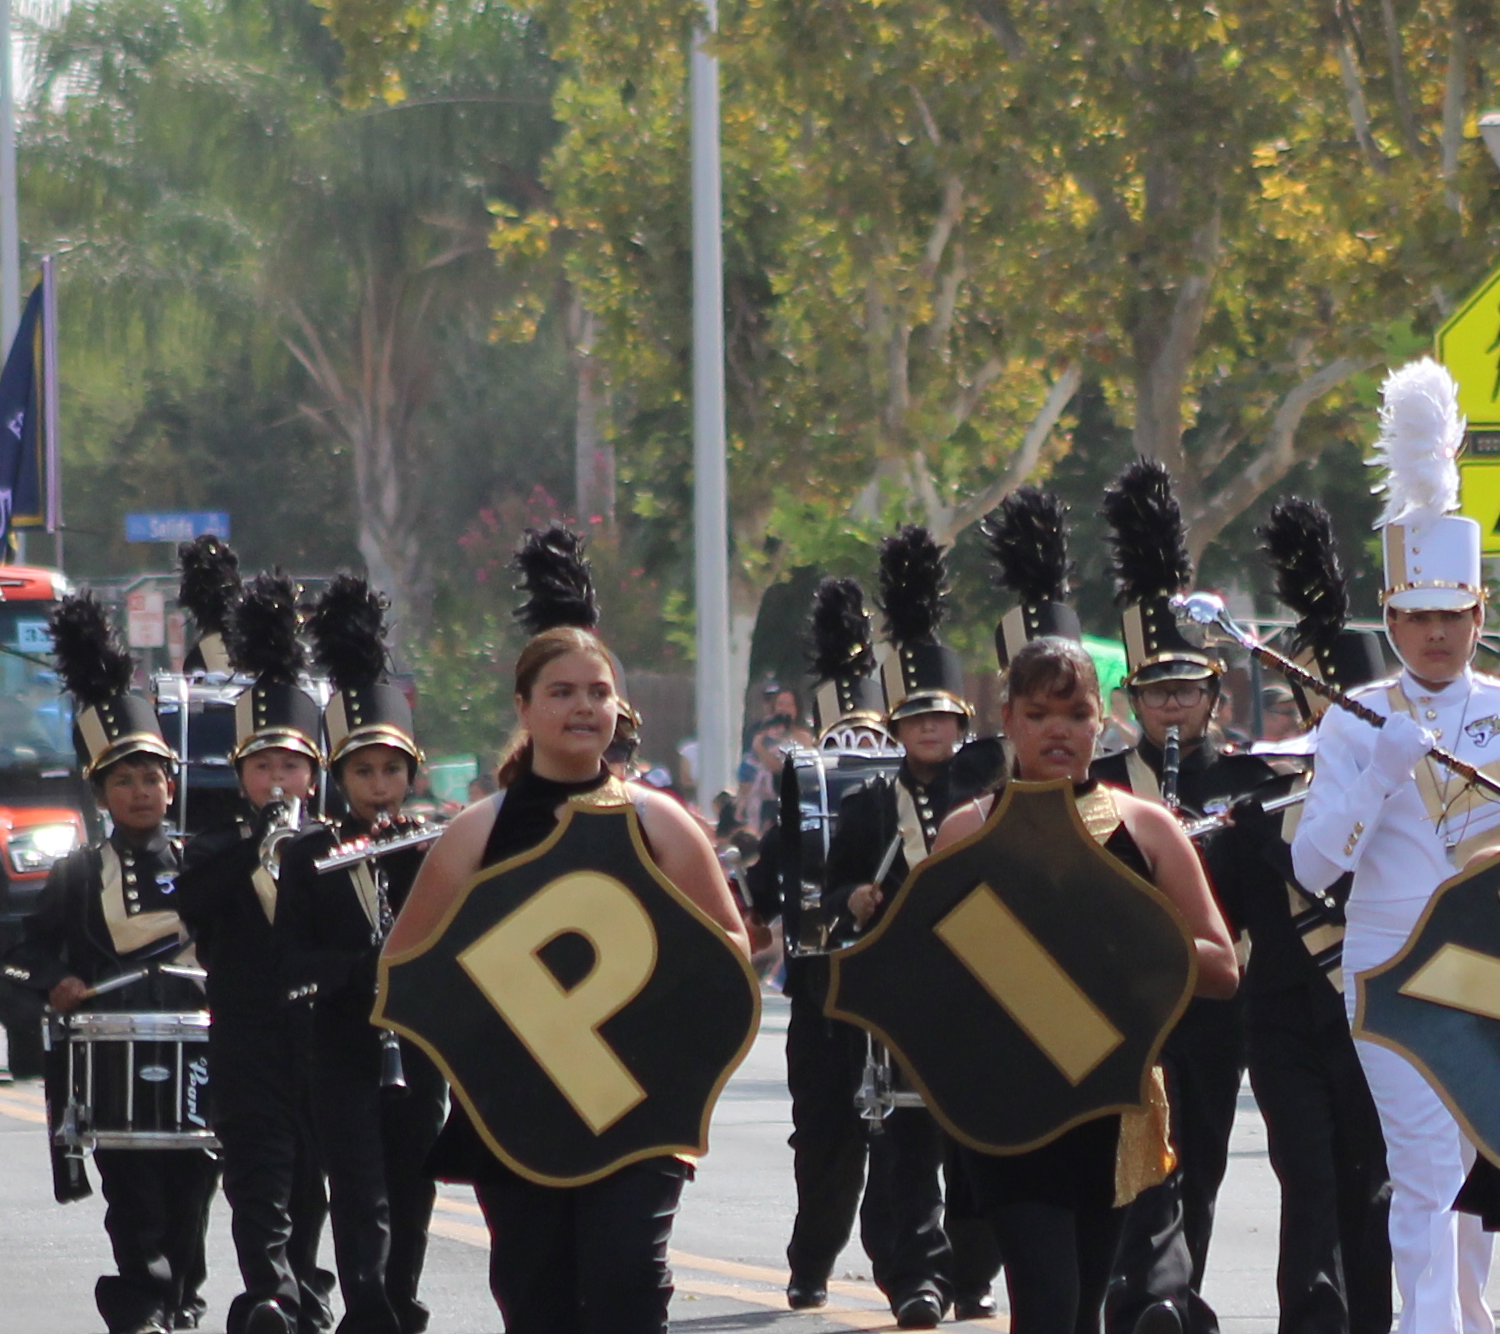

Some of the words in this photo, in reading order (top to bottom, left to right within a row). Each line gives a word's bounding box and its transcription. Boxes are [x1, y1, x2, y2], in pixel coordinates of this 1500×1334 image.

[456, 870, 658, 1137] P
[932, 880, 1126, 1088] I
[187, 1056, 209, 1128] Pearl
